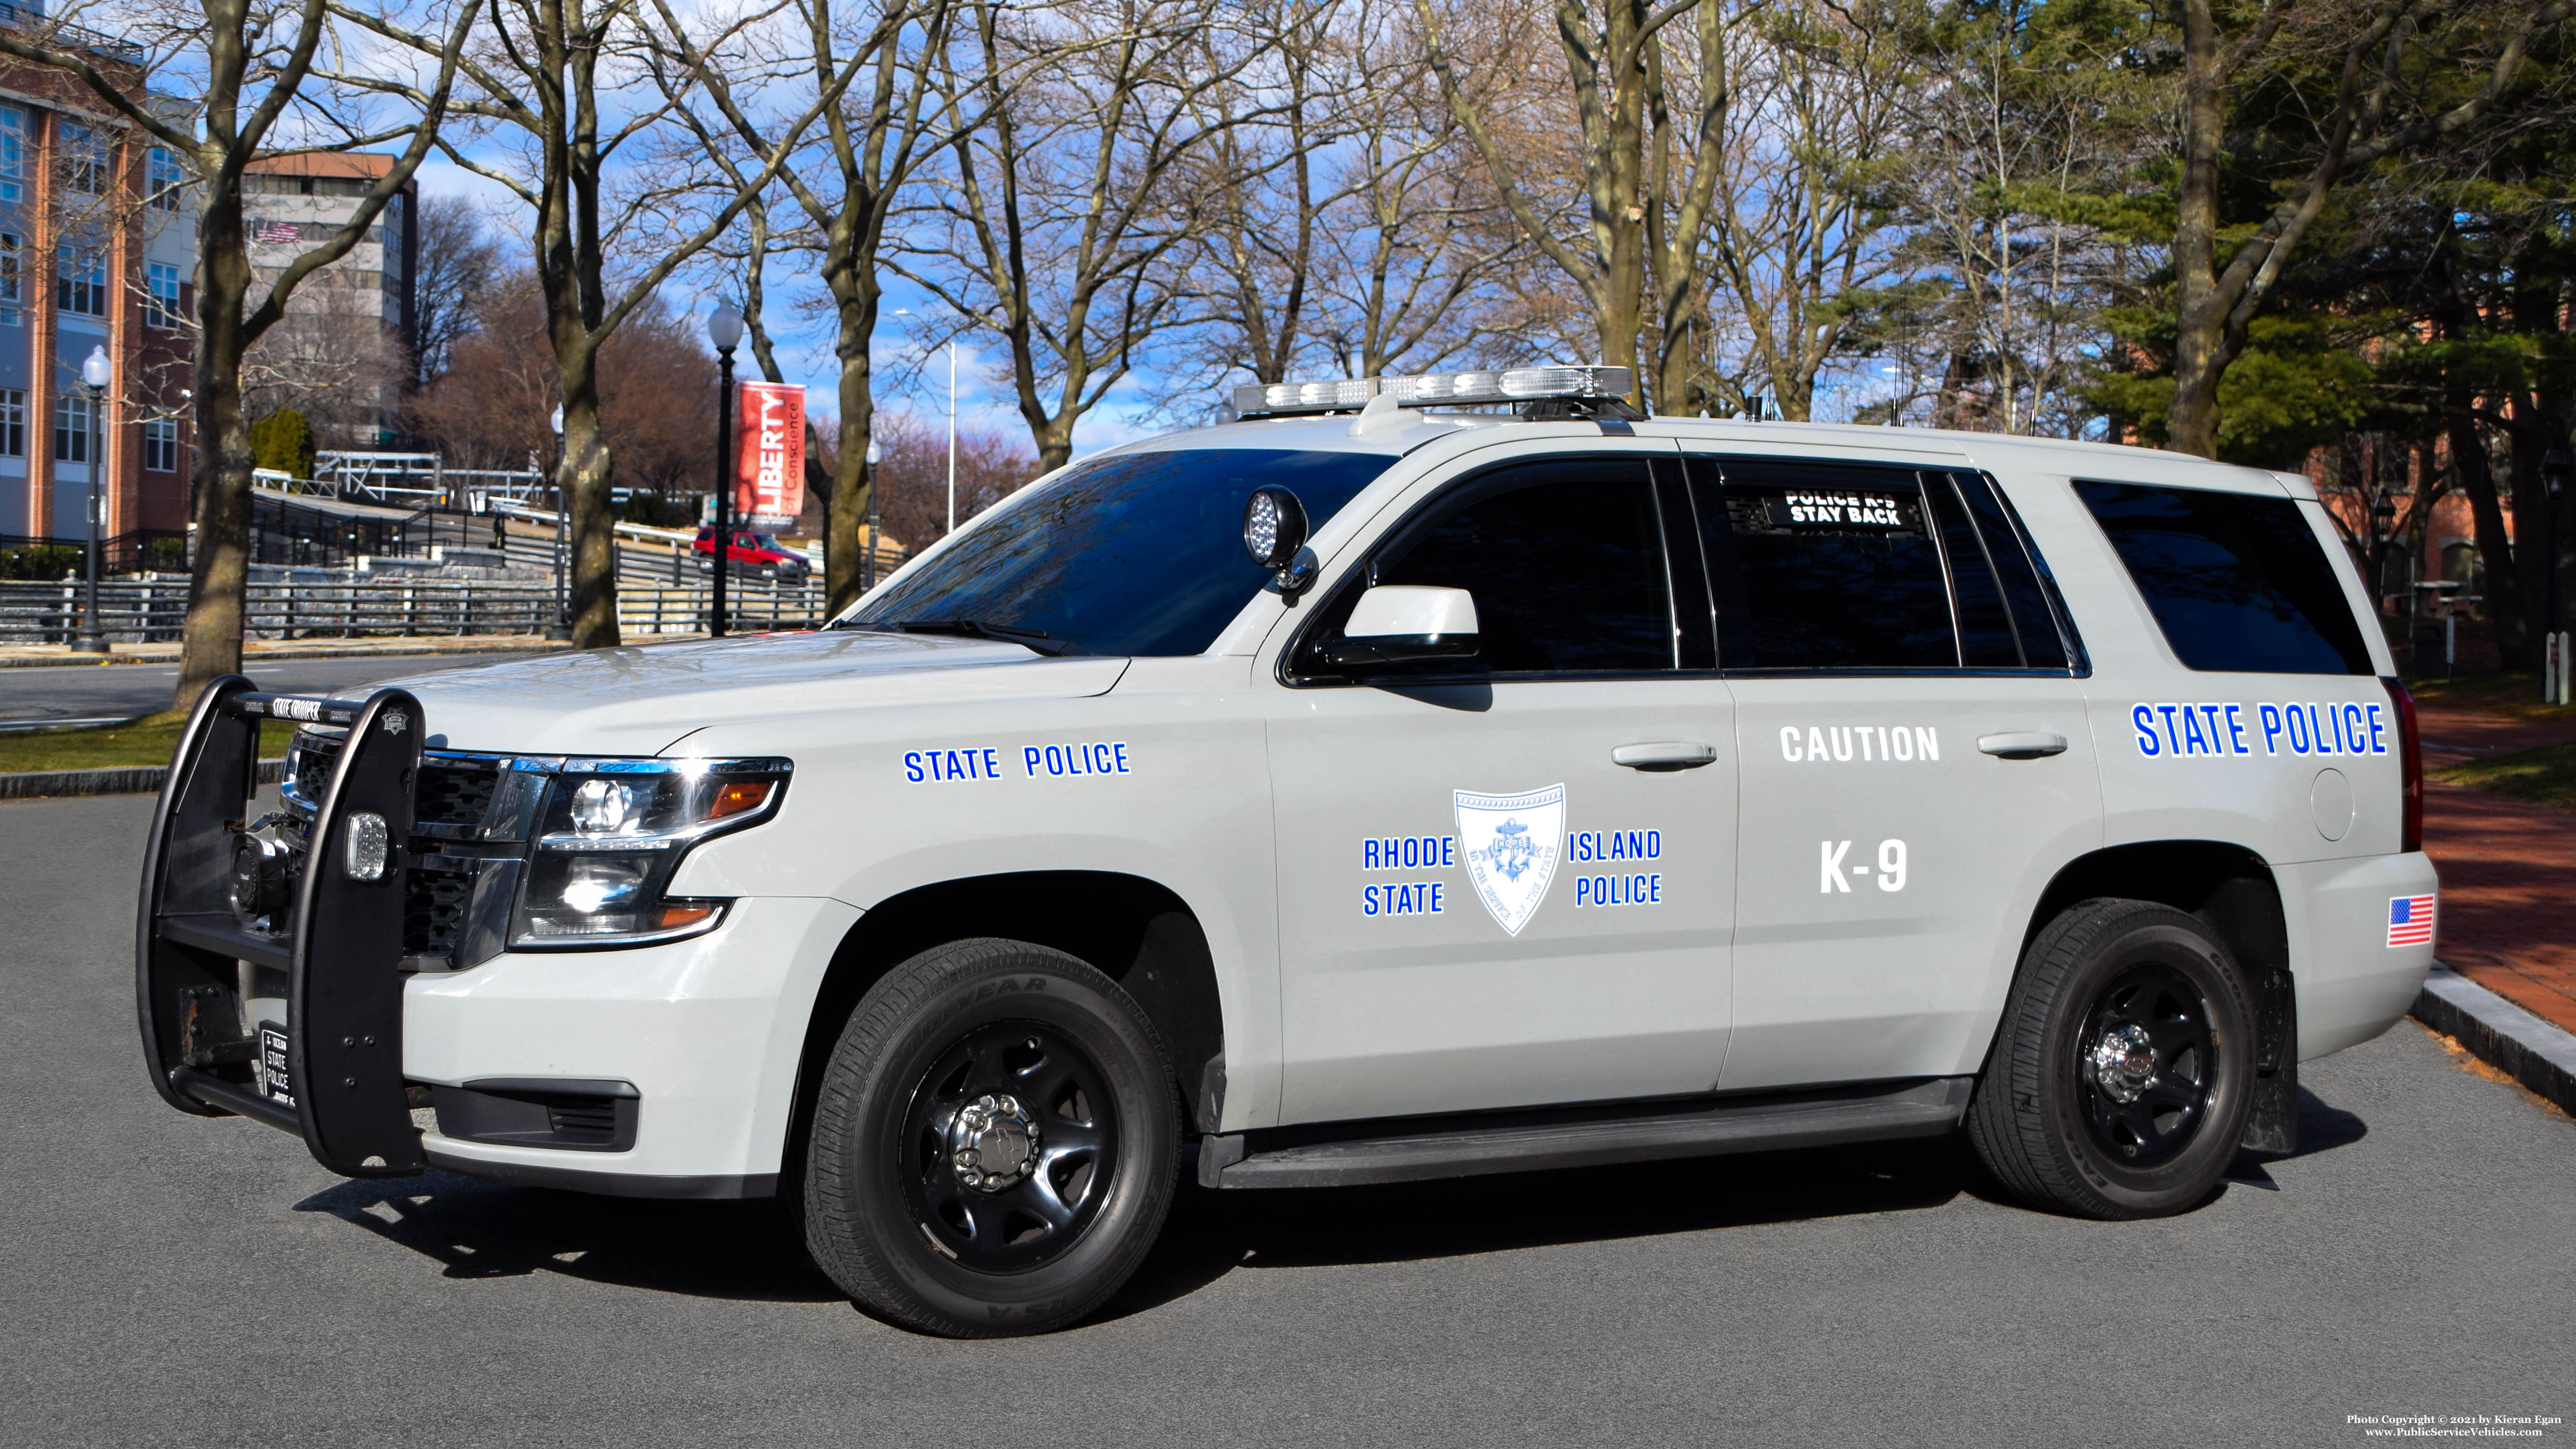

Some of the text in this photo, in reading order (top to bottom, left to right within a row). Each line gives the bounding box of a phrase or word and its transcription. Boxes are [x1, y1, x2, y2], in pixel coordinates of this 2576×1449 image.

[758, 391, 784, 512] LIBERTY
[782, 403, 798, 511] of Conscience
[1785, 490, 1895, 509] POLICE K-9
[1790, 506, 1901, 525] STAY BACK
[273, 698, 321, 721] STATE TROOPER
[1780, 726, 1939, 762] CAUTION
[2130, 702, 2387, 759] STATE POLICE
[903, 741, 1132, 784] STATE POLICE
[1363, 829, 1661, 870] RHODE ISLAND
[1499, 839, 1524, 848] HOPE
[1474, 863, 1488, 885] THE
[1483, 884, 1511, 921] SERVICE
[1525, 882, 1541, 902] THE
[1538, 845, 1555, 880] STATE
[1821, 838, 1907, 893] K-9
[1362, 873, 1661, 917] STATE POLICE
[268, 1051, 286, 1070] STATE
[273, 1038, 286, 1051] OCEAN
[267, 1068, 288, 1089] POLICE
